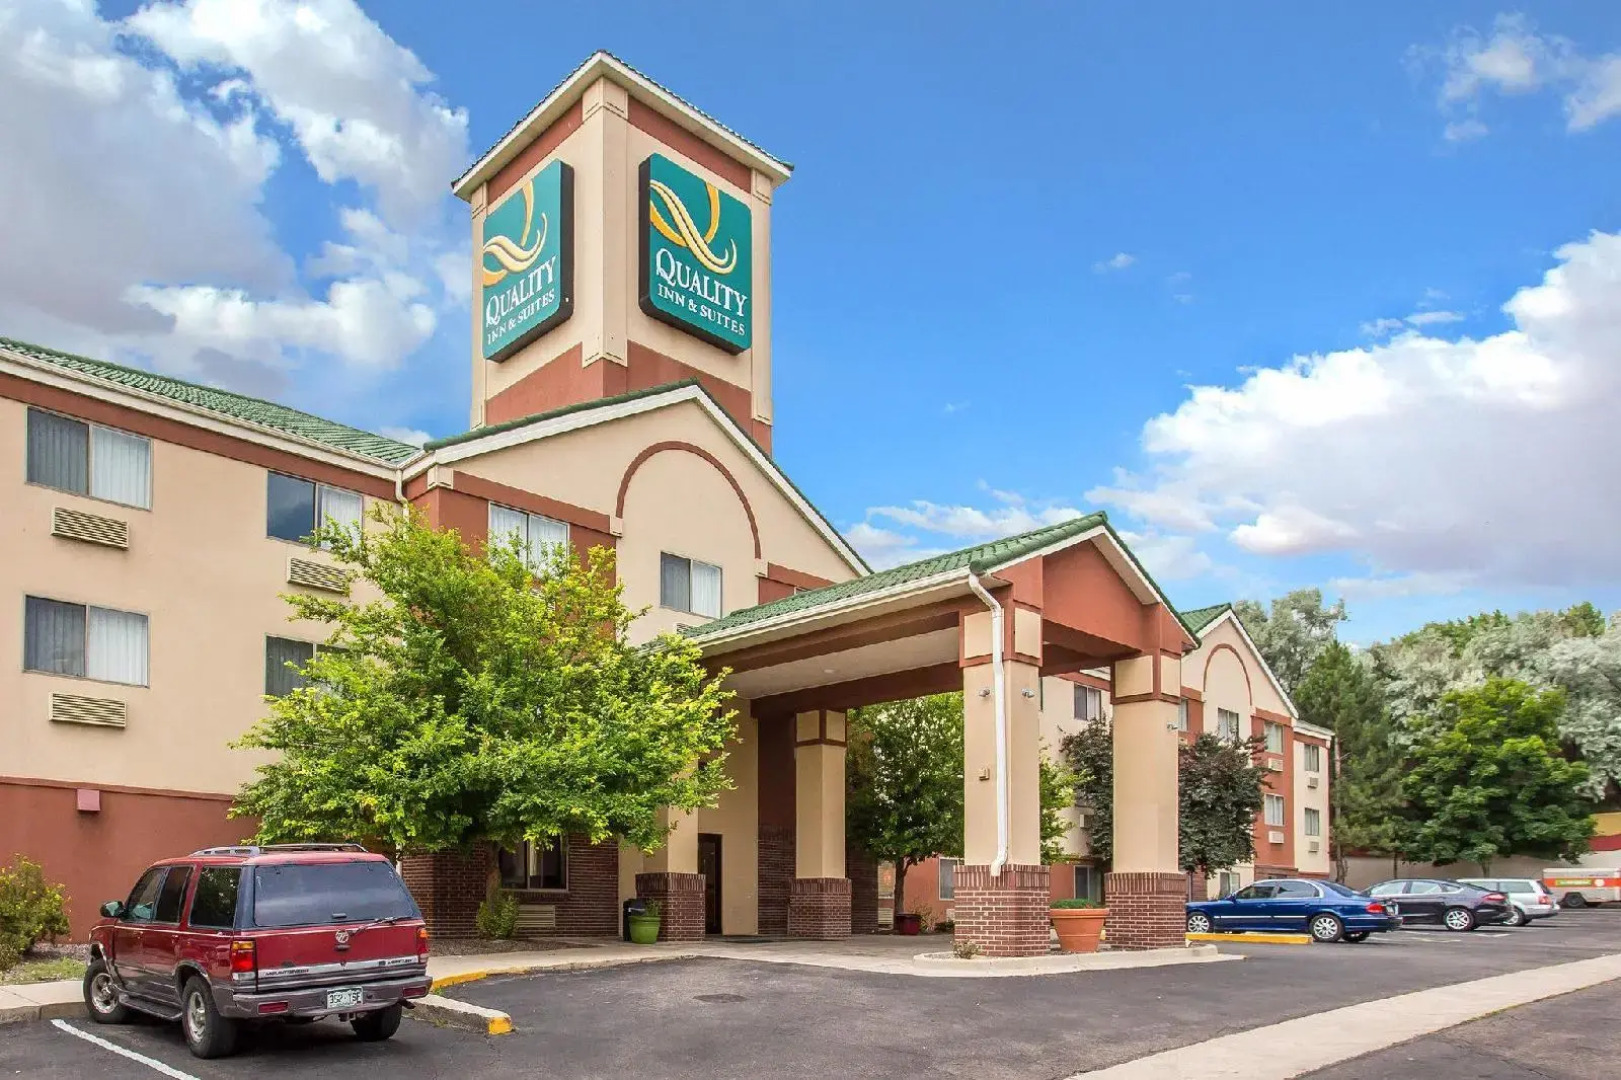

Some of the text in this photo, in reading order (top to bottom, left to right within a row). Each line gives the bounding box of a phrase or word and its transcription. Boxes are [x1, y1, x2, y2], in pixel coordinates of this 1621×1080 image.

[485, 256, 556, 327] QUALITY
[656, 248, 747, 316] QUALITY
[658, 283, 745, 336] INN & SUITES
[487, 288, 555, 345] INN & SUITES
